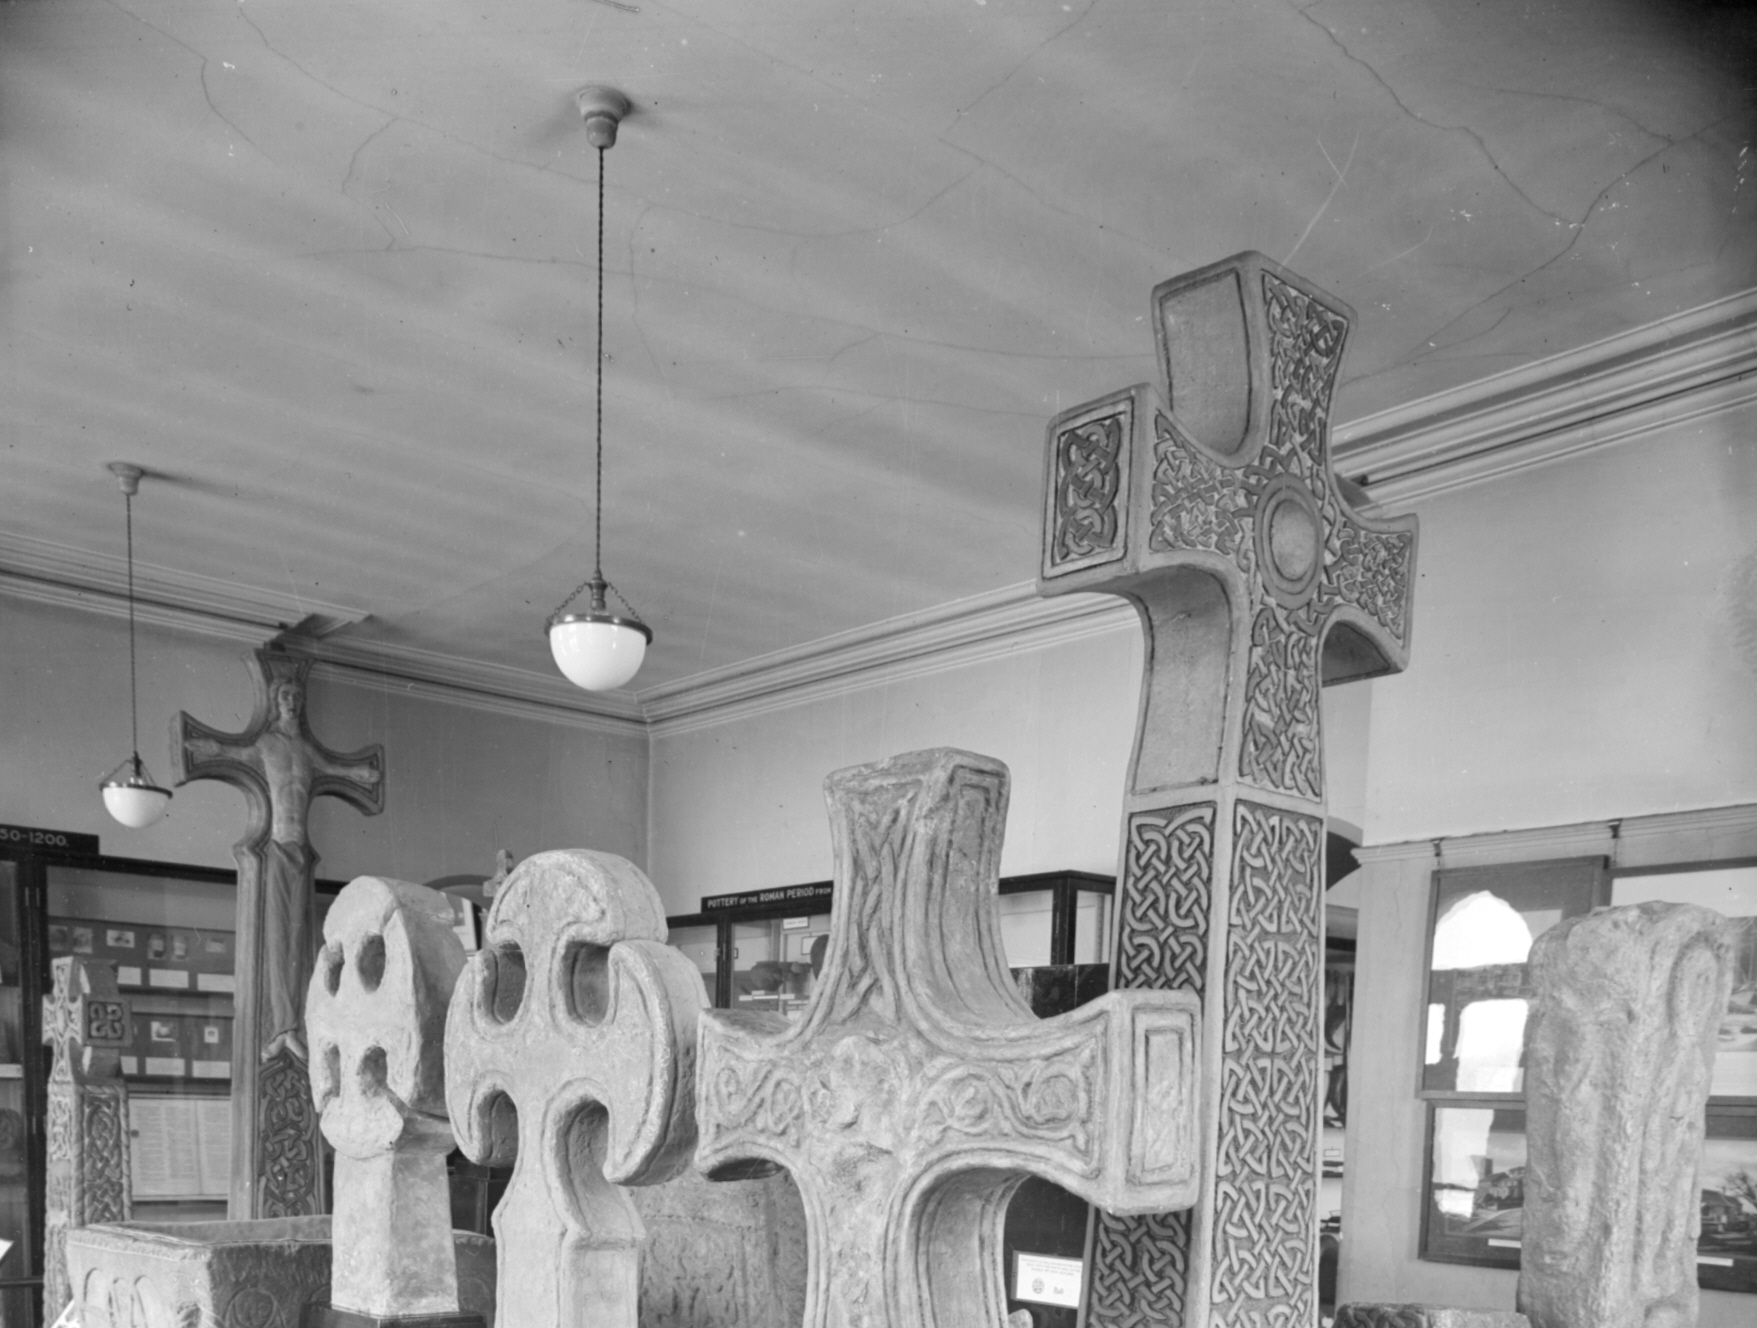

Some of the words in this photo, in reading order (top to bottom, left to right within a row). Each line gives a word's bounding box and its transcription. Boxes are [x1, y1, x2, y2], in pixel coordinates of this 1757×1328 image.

[708, 896, 738, 908] POTTERY
[760, 891, 785, 902] ROMAN
[787, 887, 814, 899] PERIOD
